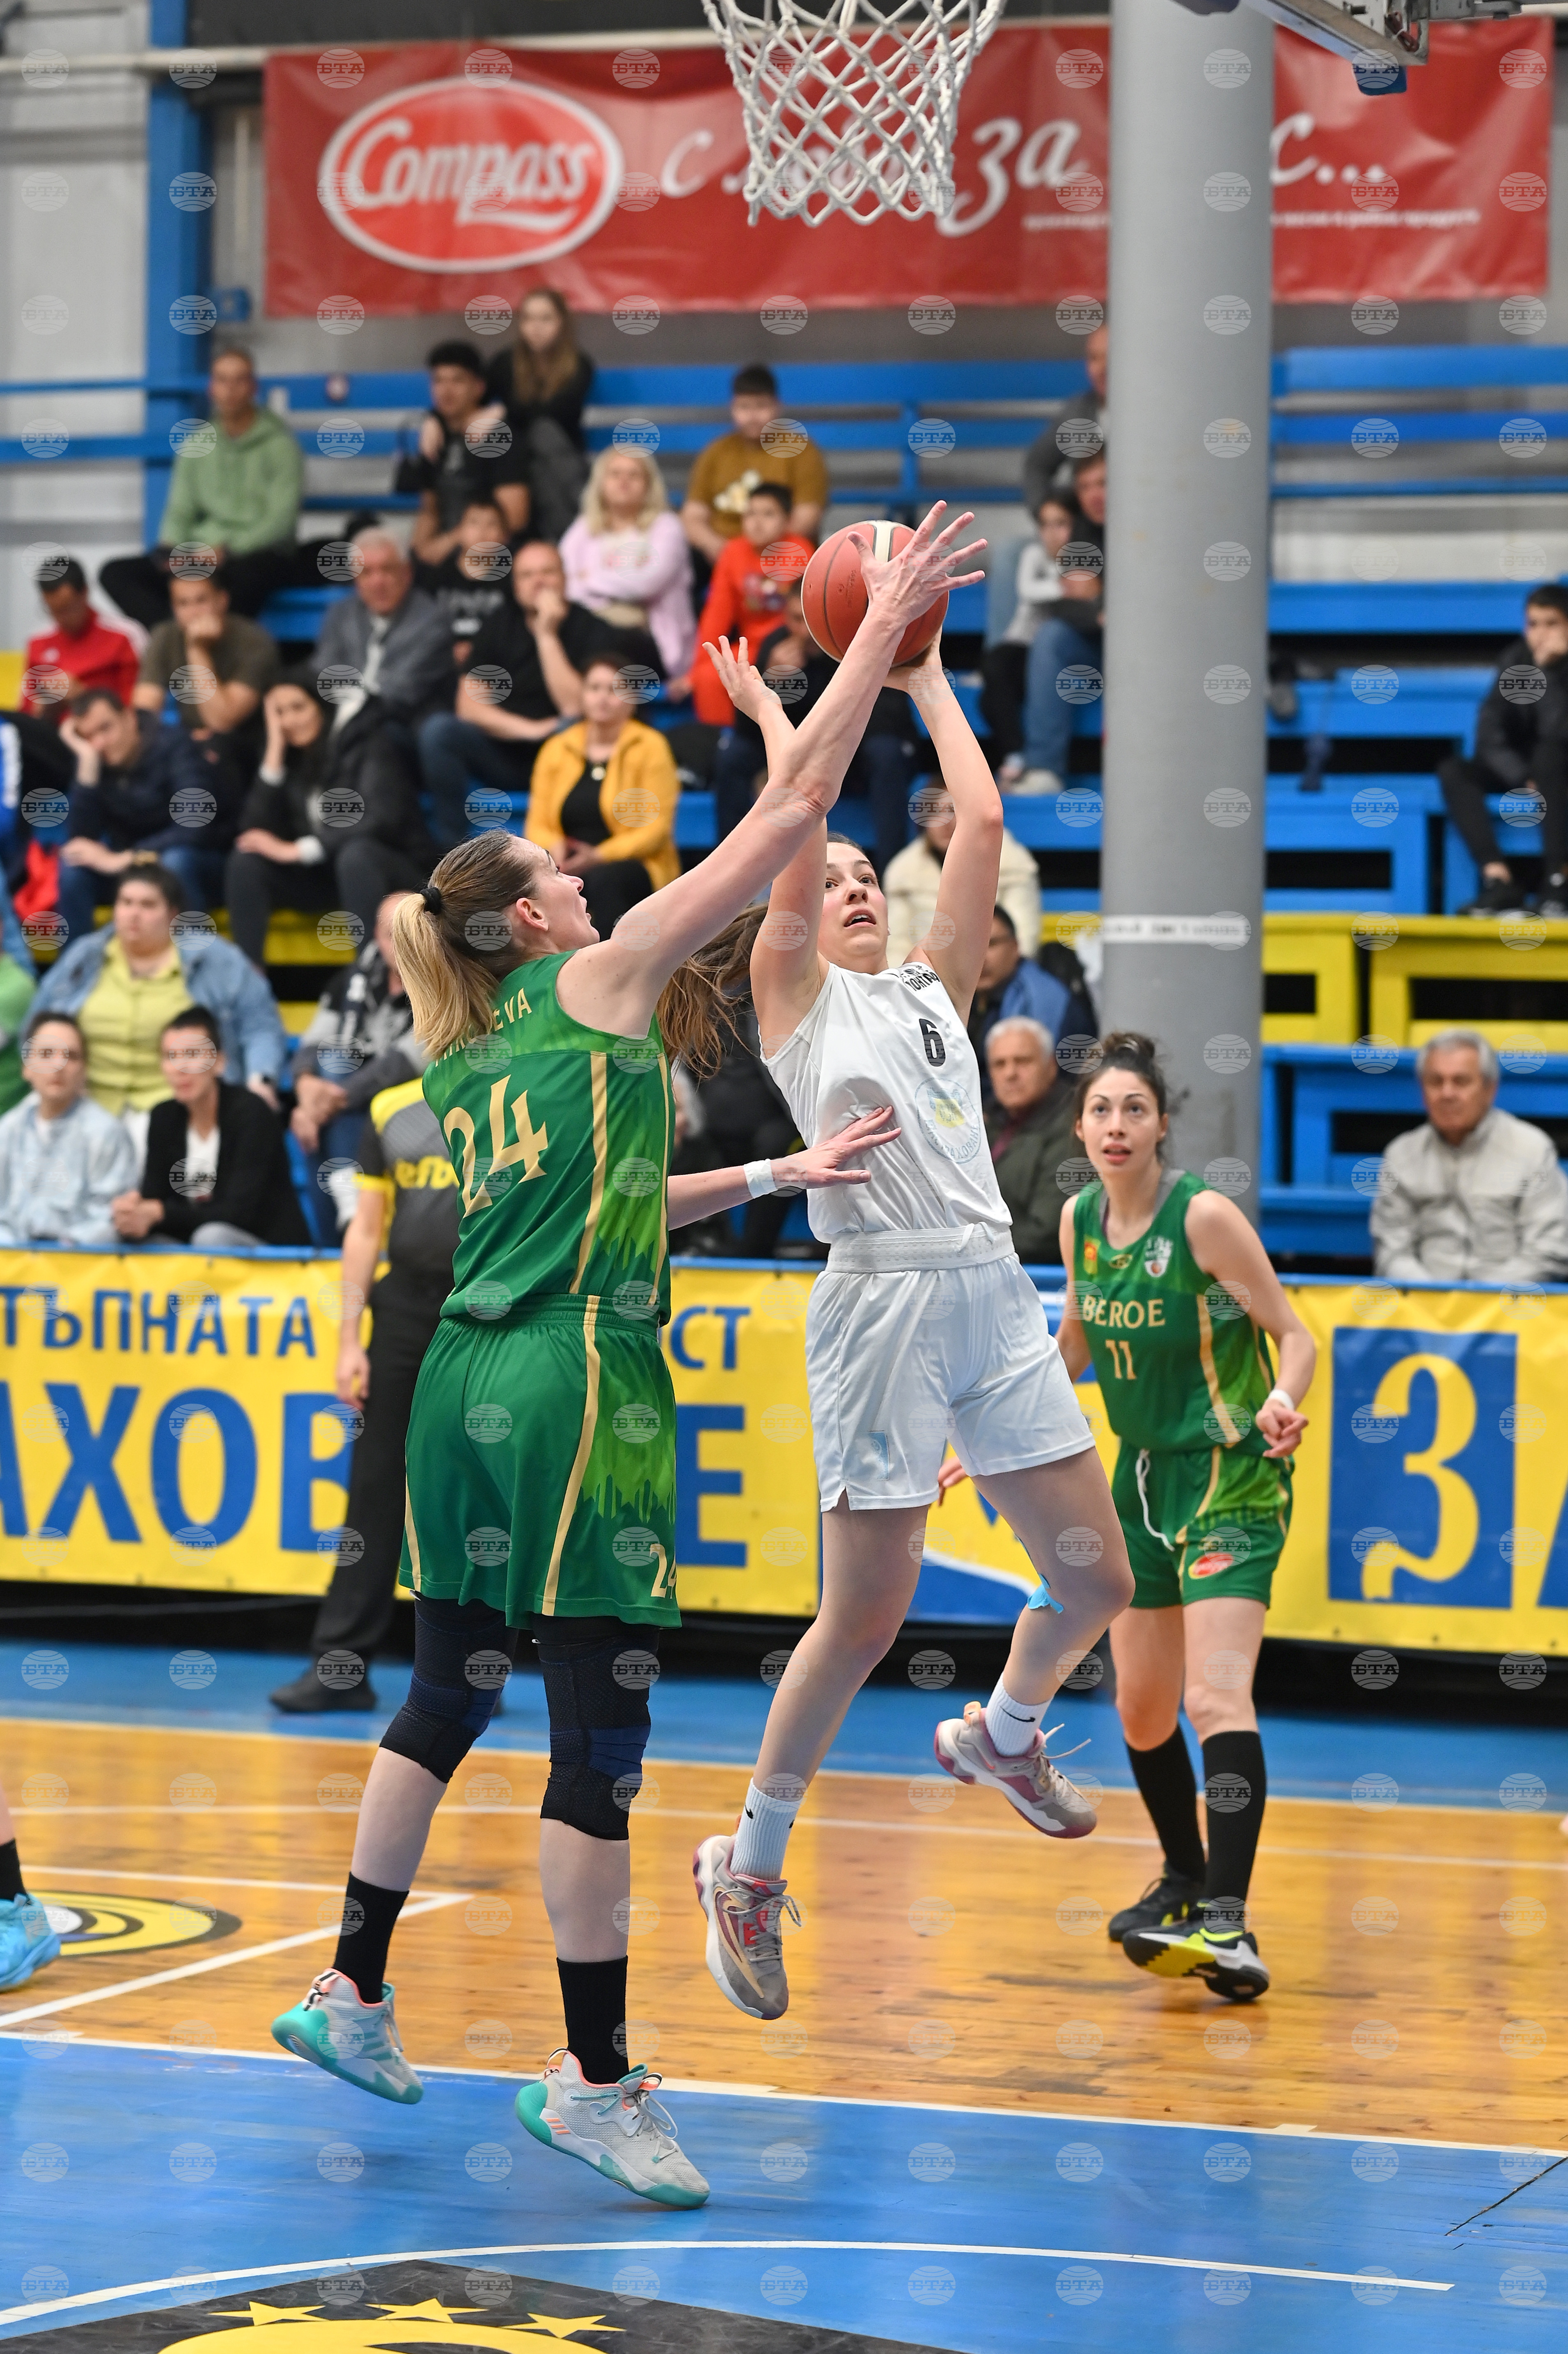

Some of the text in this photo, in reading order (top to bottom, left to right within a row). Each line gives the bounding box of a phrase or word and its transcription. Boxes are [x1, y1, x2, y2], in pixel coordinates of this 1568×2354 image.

[346, 117, 596, 228] Compass
[919, 1018, 946, 1067] 6
[443, 1074, 548, 1218] 24
[660, 1304, 751, 1370] СТ
[1082, 1294, 1166, 1329] BEROE
[1105, 1339, 1136, 1380] 11
